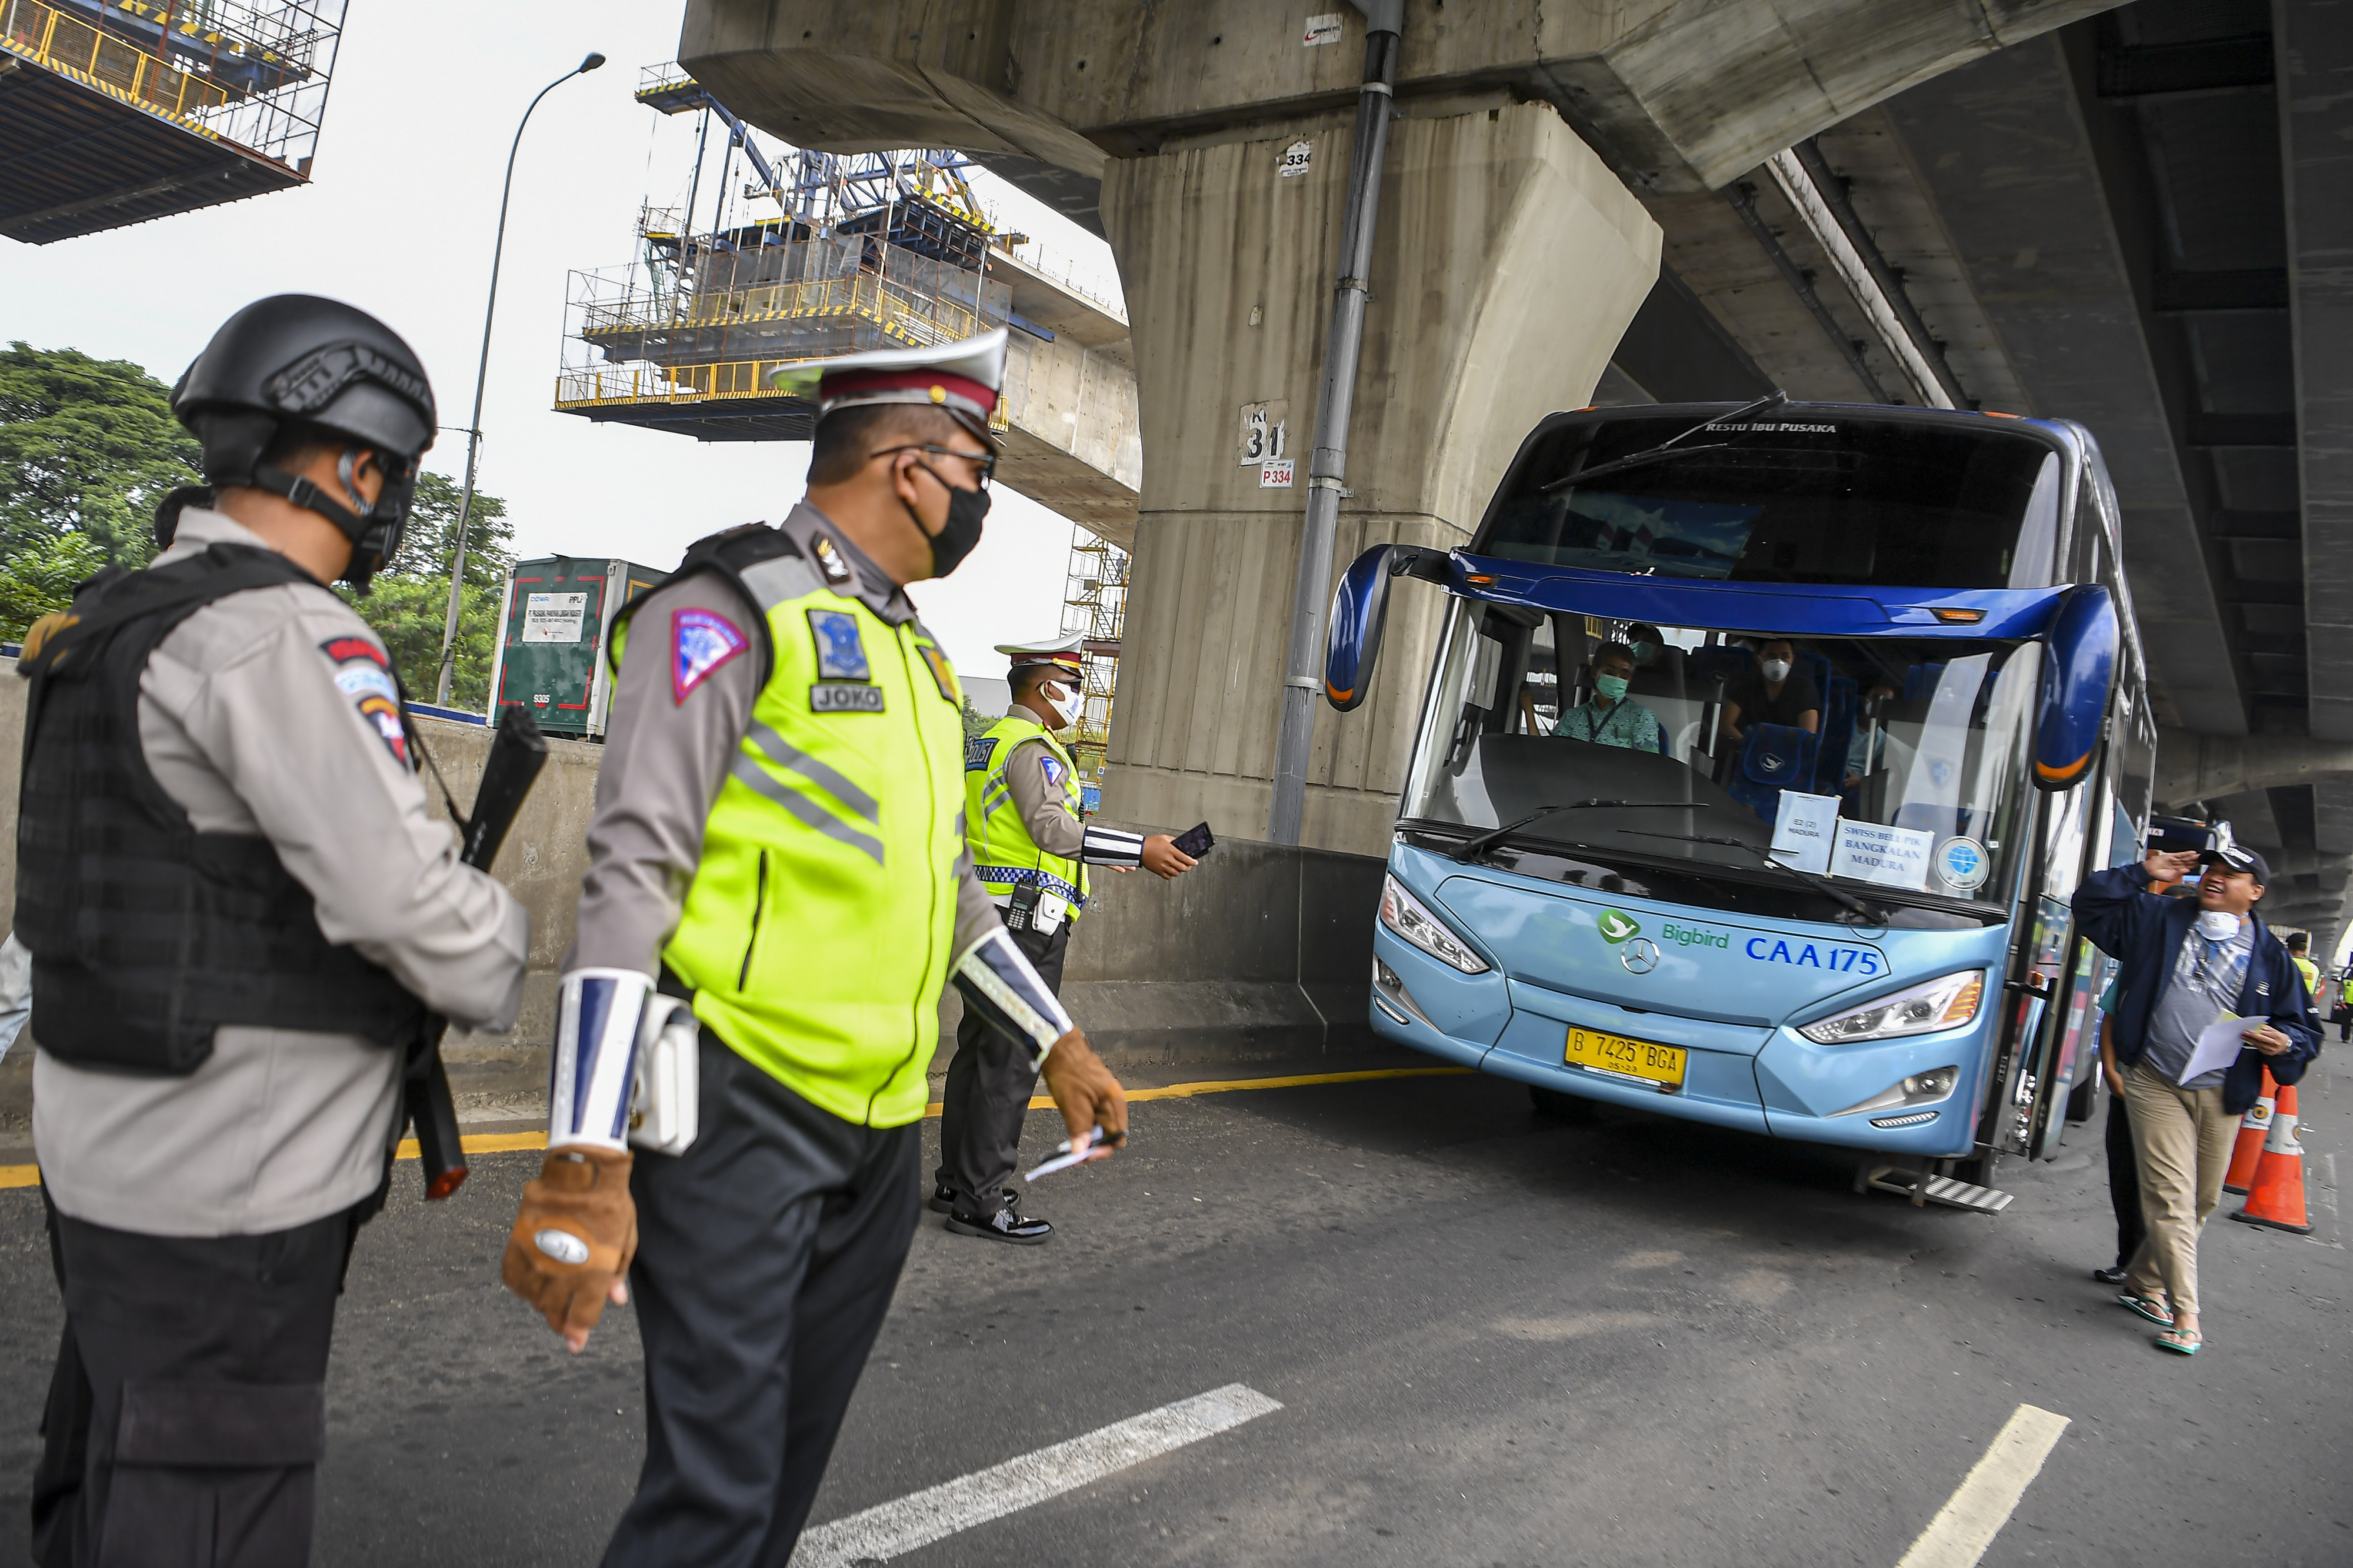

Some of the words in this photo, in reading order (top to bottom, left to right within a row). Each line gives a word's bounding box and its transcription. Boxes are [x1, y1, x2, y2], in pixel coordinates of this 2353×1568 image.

[1287, 153, 1311, 166] 334
[1751, 423, 1775, 431] IBU
[1778, 423, 1837, 433] PUSAKA
[1263, 471, 1271, 483] P
[1272, 470, 1291, 483] 334
[819, 690, 878, 705] JOKO
[1788, 827, 1820, 838] MADURA
[1844, 826, 1875, 839] SWISS
[1878, 832, 1901, 842] BELL
[1845, 839, 1921, 860] BANGKALAN
[1851, 854, 1905, 872] MADURA
[1662, 923, 1730, 949] Bigbird
[1574, 1032, 1585, 1052] B
[1597, 1035, 1638, 1062] 7425
[1647, 1046, 1677, 1072] BGA
